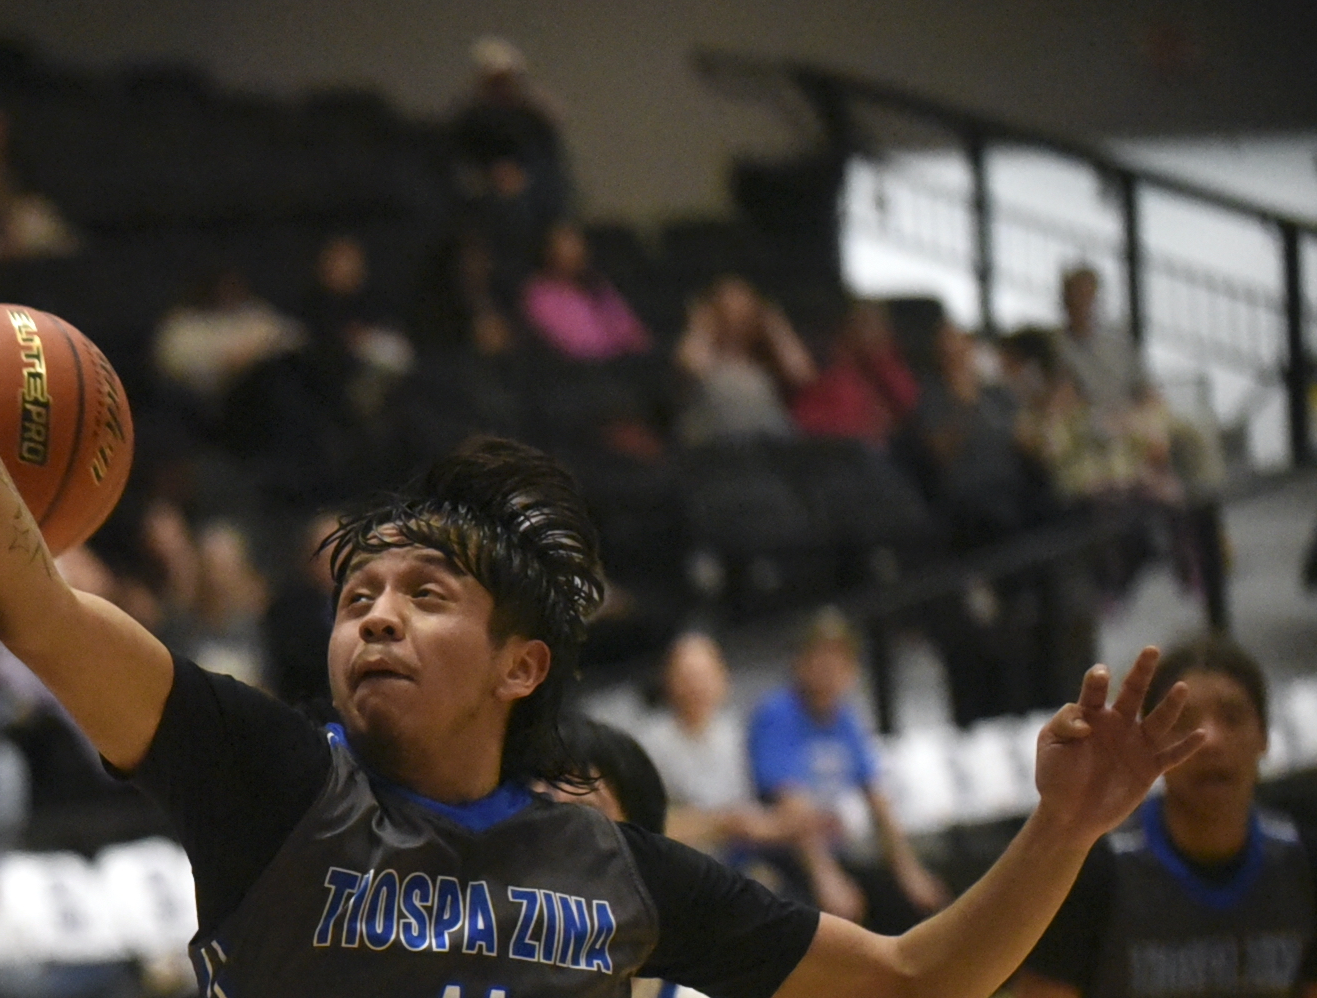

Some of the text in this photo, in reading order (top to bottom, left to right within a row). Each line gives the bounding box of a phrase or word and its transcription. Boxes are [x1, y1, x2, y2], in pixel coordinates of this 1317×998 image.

[21, 401, 49, 463] PRO
[312, 866, 617, 975] TIOSPA ZINA
